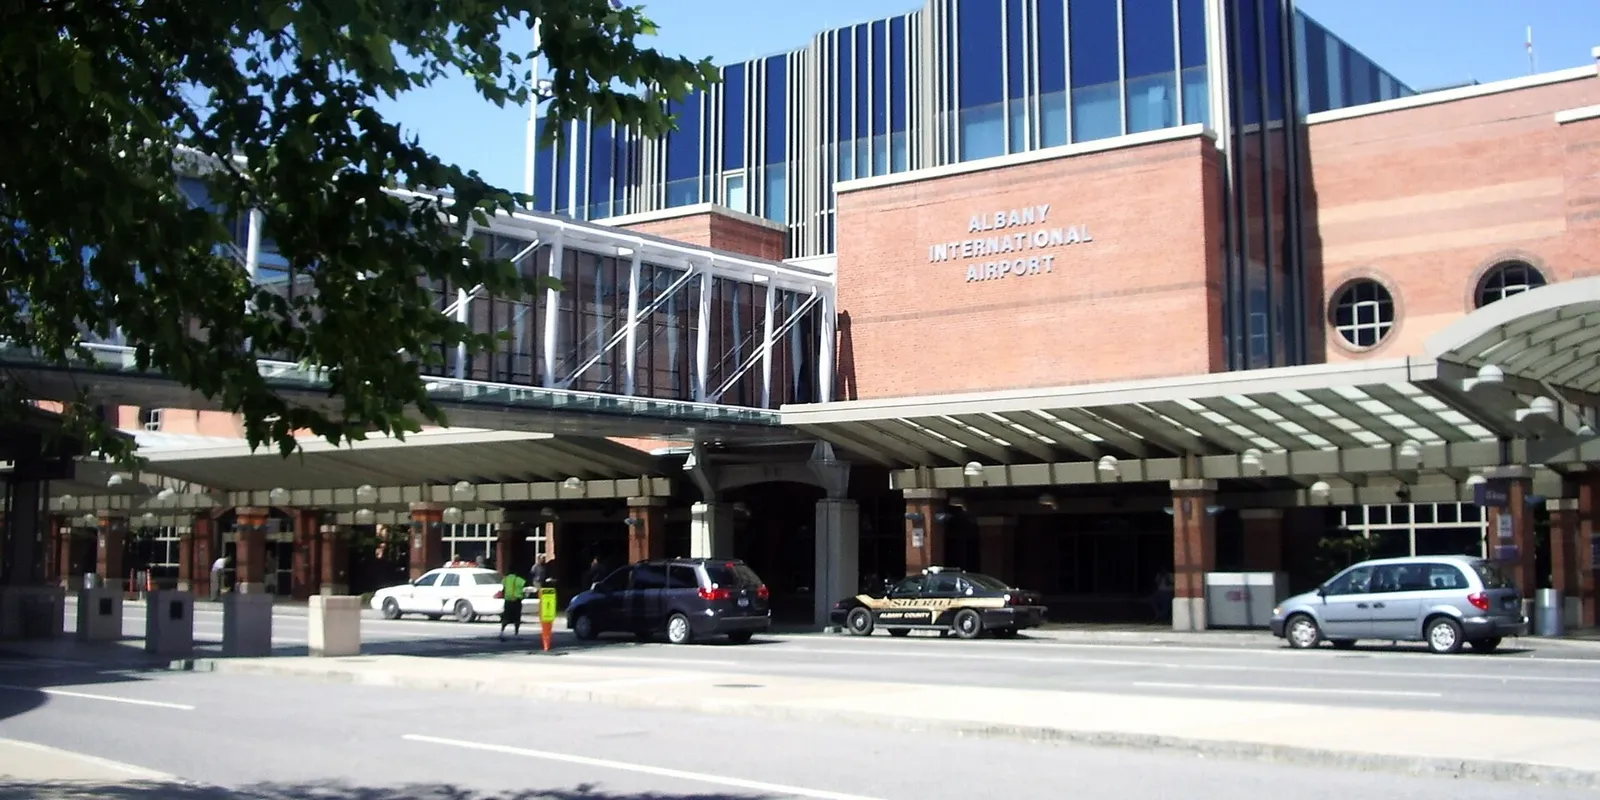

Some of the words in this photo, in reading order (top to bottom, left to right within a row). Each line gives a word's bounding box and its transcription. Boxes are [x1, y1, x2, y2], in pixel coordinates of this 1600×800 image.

[968, 204, 1051, 233] ALBANY
[928, 224, 1093, 263] INTERNATIONAL
[966, 255, 1055, 283] AIRPORT
[891, 599, 954, 607] SHERIFF
